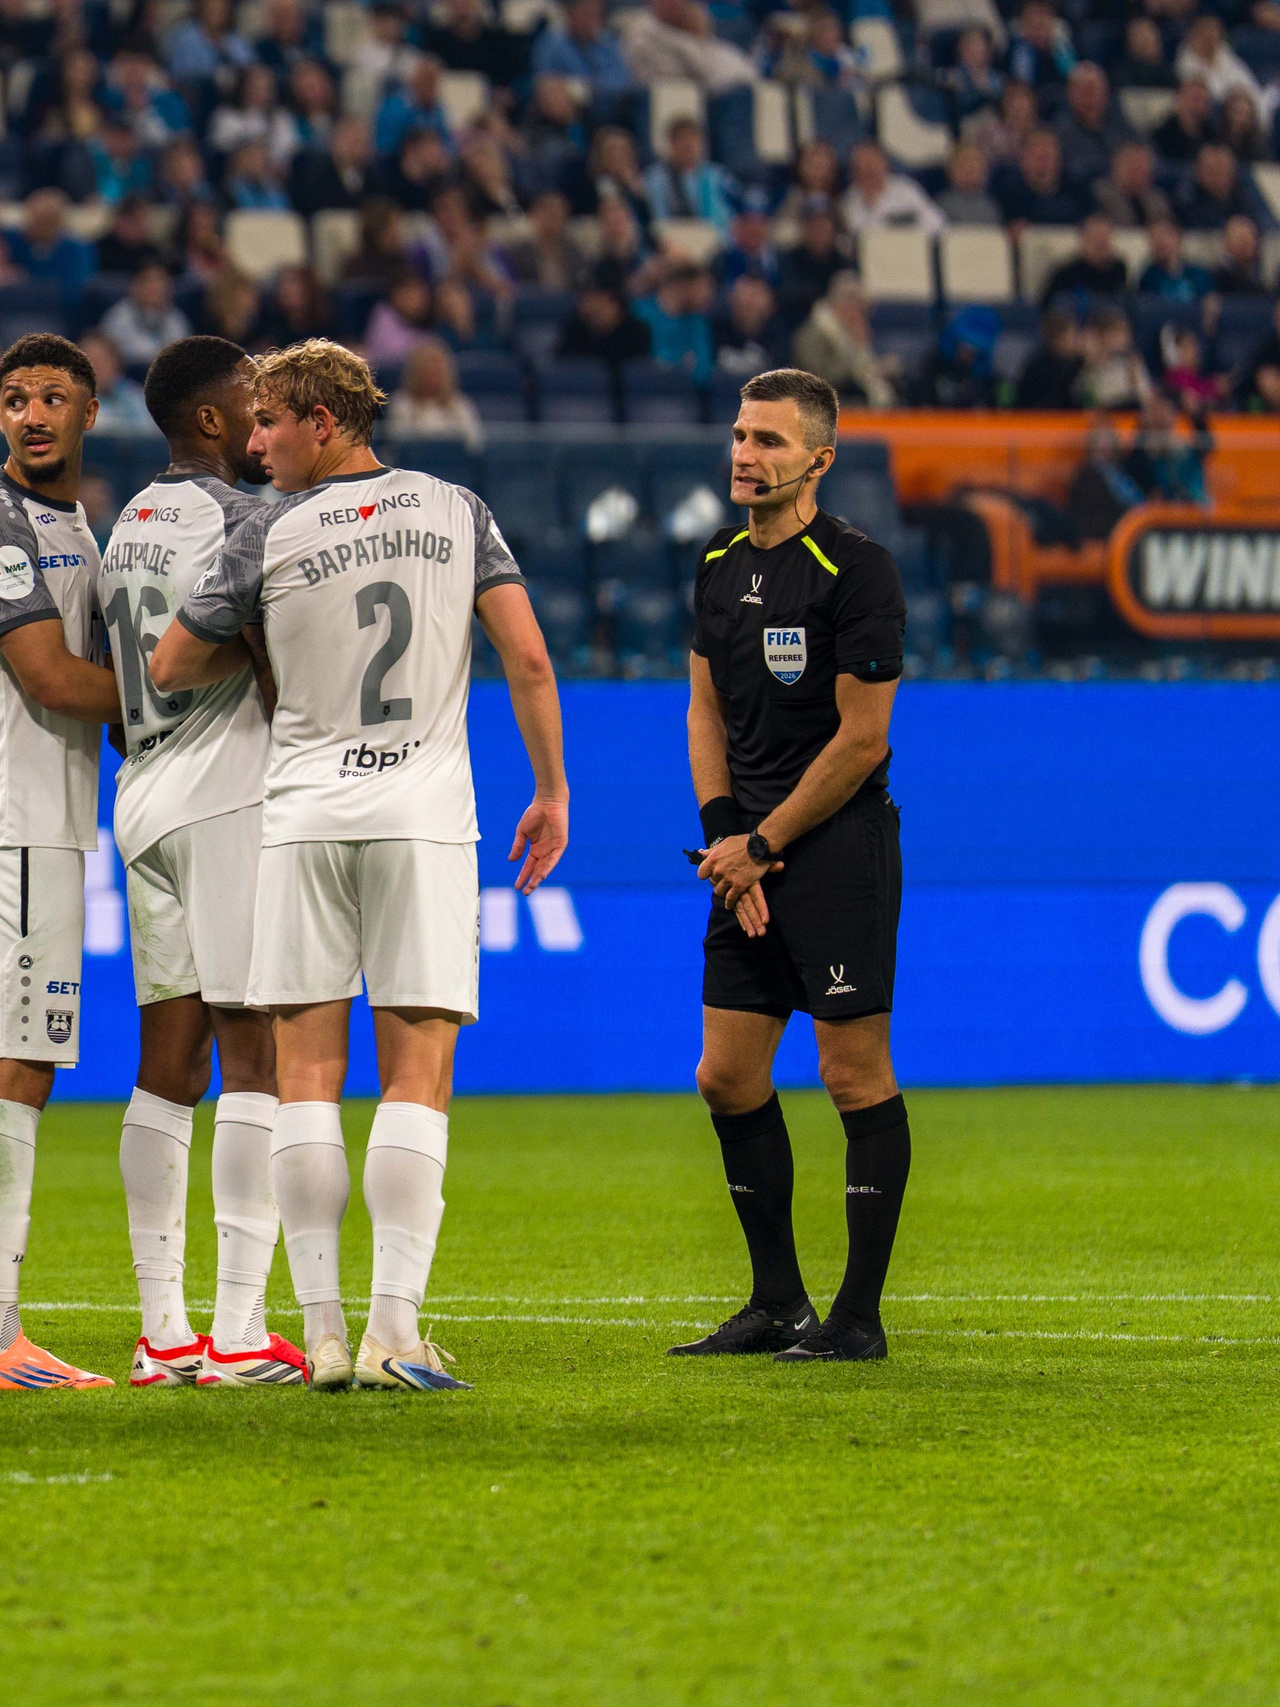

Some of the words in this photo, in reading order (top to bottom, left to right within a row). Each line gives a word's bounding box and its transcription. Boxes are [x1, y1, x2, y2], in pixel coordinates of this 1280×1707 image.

[297, 529, 453, 586] ВАРАТЫНОВ
[4, 561, 28, 574] МИР
[767, 631, 802, 646] FIFA
[355, 581, 413, 727] 2
[768, 653, 804, 662] REFEREE
[825, 984, 857, 995] JÖGEL
